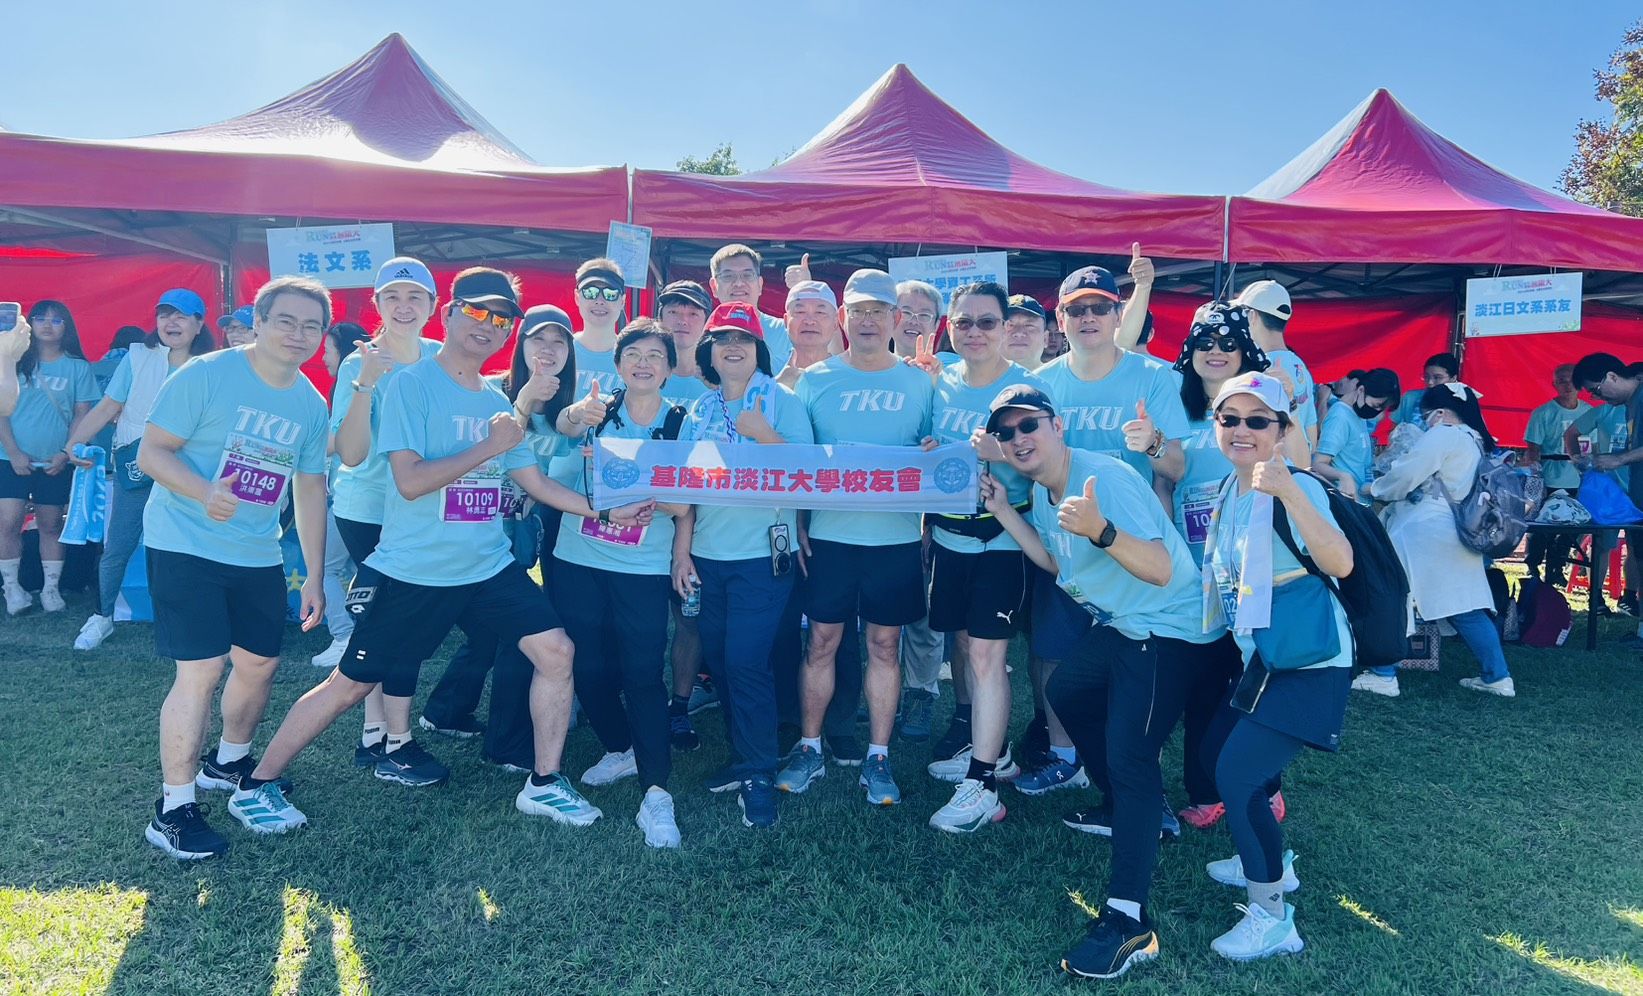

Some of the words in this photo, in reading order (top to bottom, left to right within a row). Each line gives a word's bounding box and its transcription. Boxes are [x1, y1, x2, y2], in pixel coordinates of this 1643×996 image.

[298, 250, 372, 273] 法文系
[1475, 300, 1571, 317] 淡江日文系系友
[840, 389, 905, 412] TKU
[235, 405, 302, 446] TKU
[451, 415, 489, 443] TK
[1061, 405, 1123, 431] TKU
[649, 464, 923, 494] 基隆市淡江大學校友會
[456, 492, 494, 506] 10109
